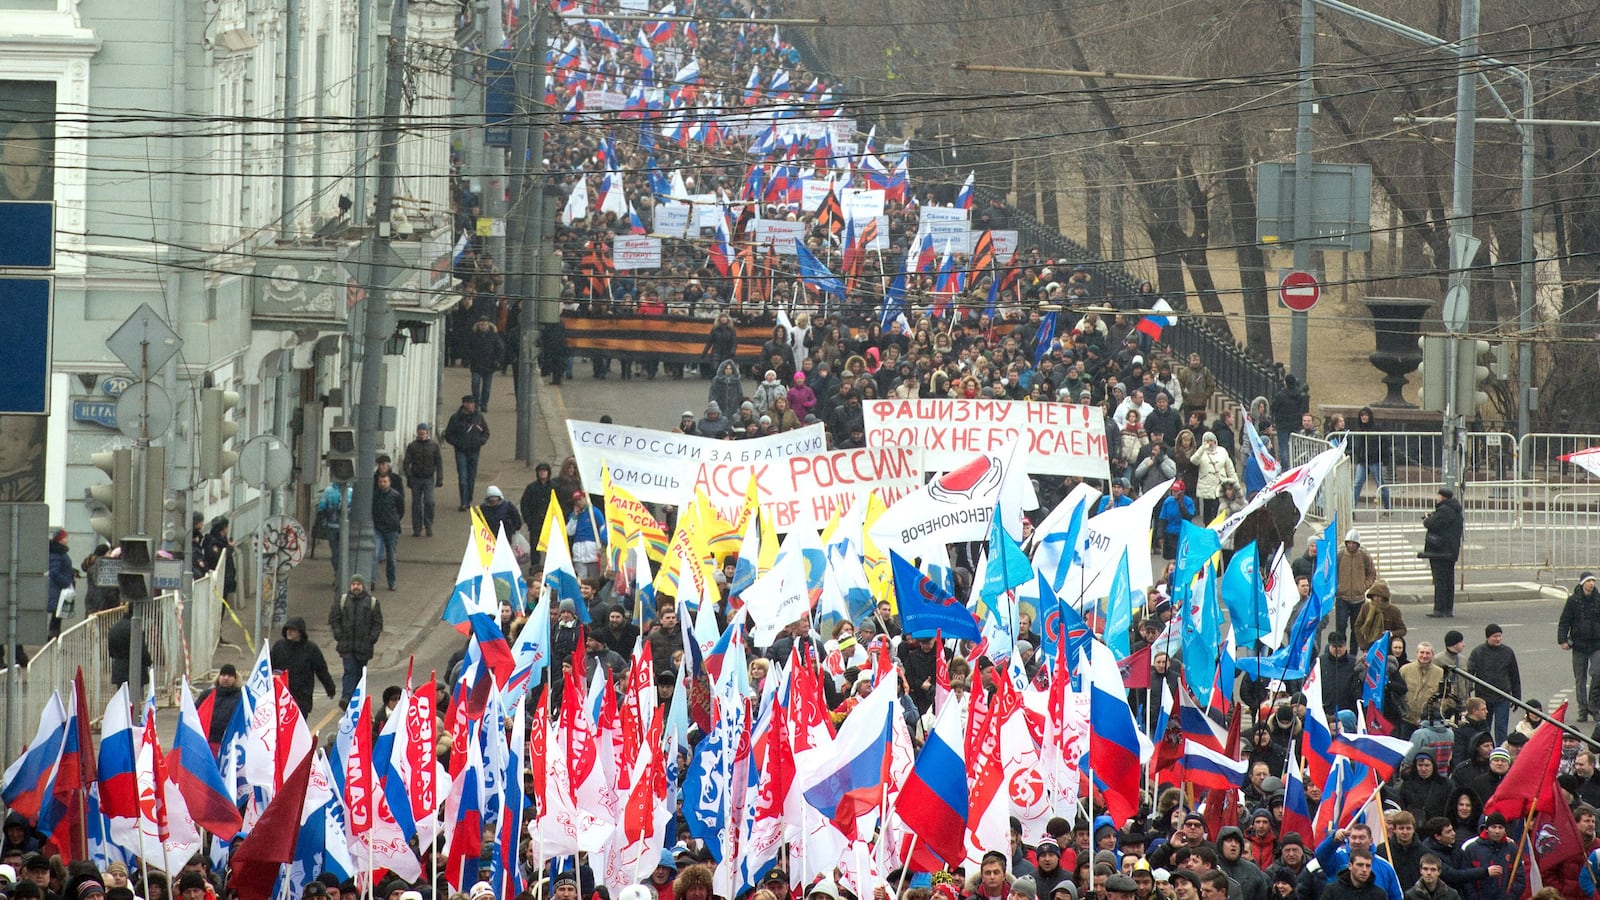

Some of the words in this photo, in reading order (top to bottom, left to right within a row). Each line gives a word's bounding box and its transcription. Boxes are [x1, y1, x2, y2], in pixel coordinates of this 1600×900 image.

[765, 236, 794, 244] Птину!
[872, 400, 1012, 422] ФАШИЗМУ
[1027, 403, 1091, 428] НЕТ!
[624, 436, 701, 458] РОССИИ
[710, 450, 732, 462] ЗА
[740, 436, 822, 462] БРАТСКУЮ
[952, 427, 982, 452] НЕ
[693, 462, 772, 497] АССК
[812, 491, 856, 522] НАШ
